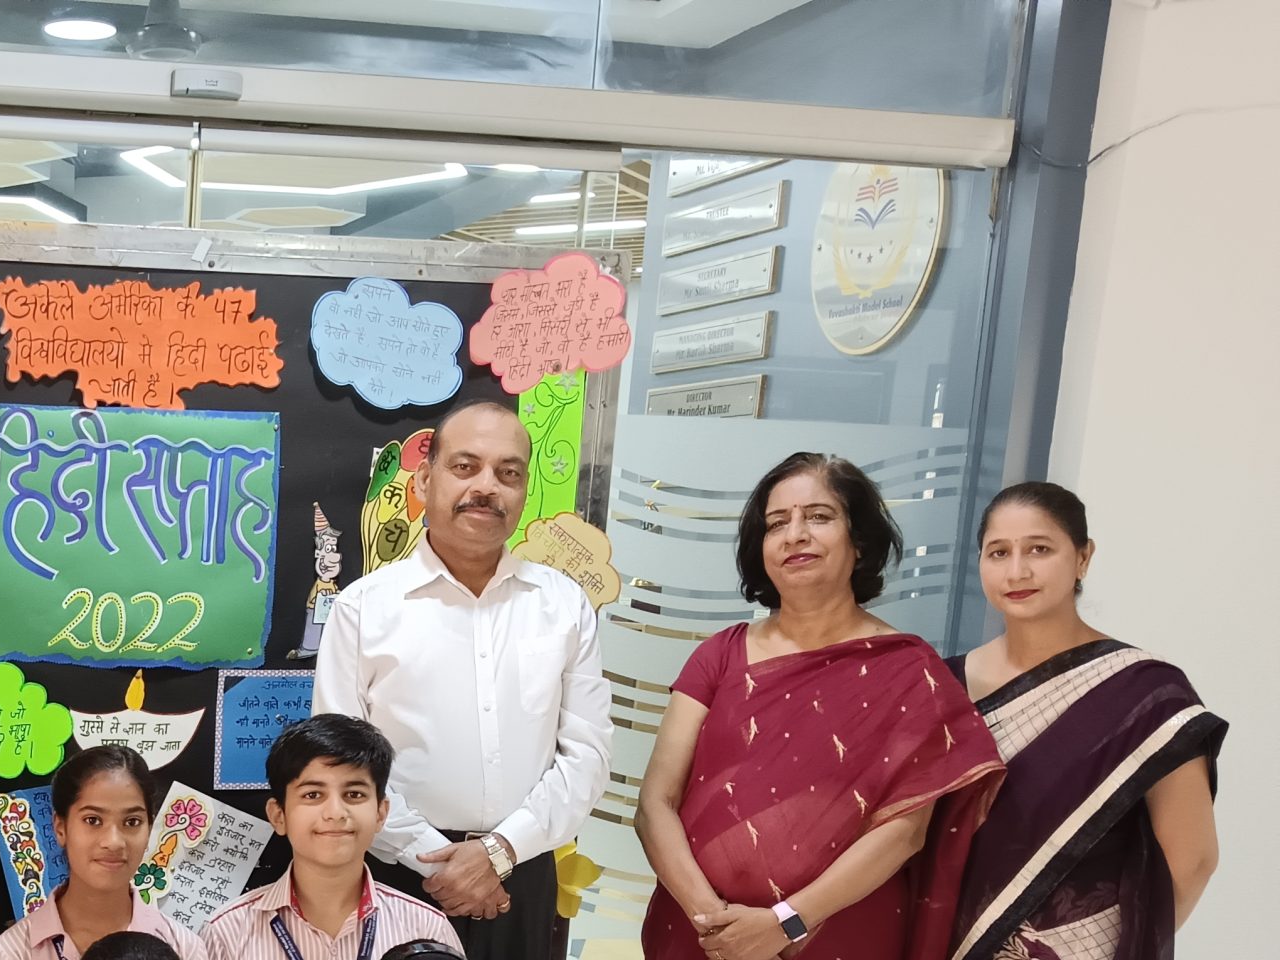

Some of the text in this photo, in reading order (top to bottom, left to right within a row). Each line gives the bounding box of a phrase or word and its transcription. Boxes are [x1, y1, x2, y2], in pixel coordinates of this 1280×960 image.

[3, 281, 243, 326] अकेले अमेरिका के 47
[89, 369, 138, 402] जाती
[123, 435, 274, 583] सप्ताह
[384, 484, 405, 509] क
[47, 588, 205, 654] 2022
[110, 716, 121, 734] से
[153, 722, 170, 736] का
